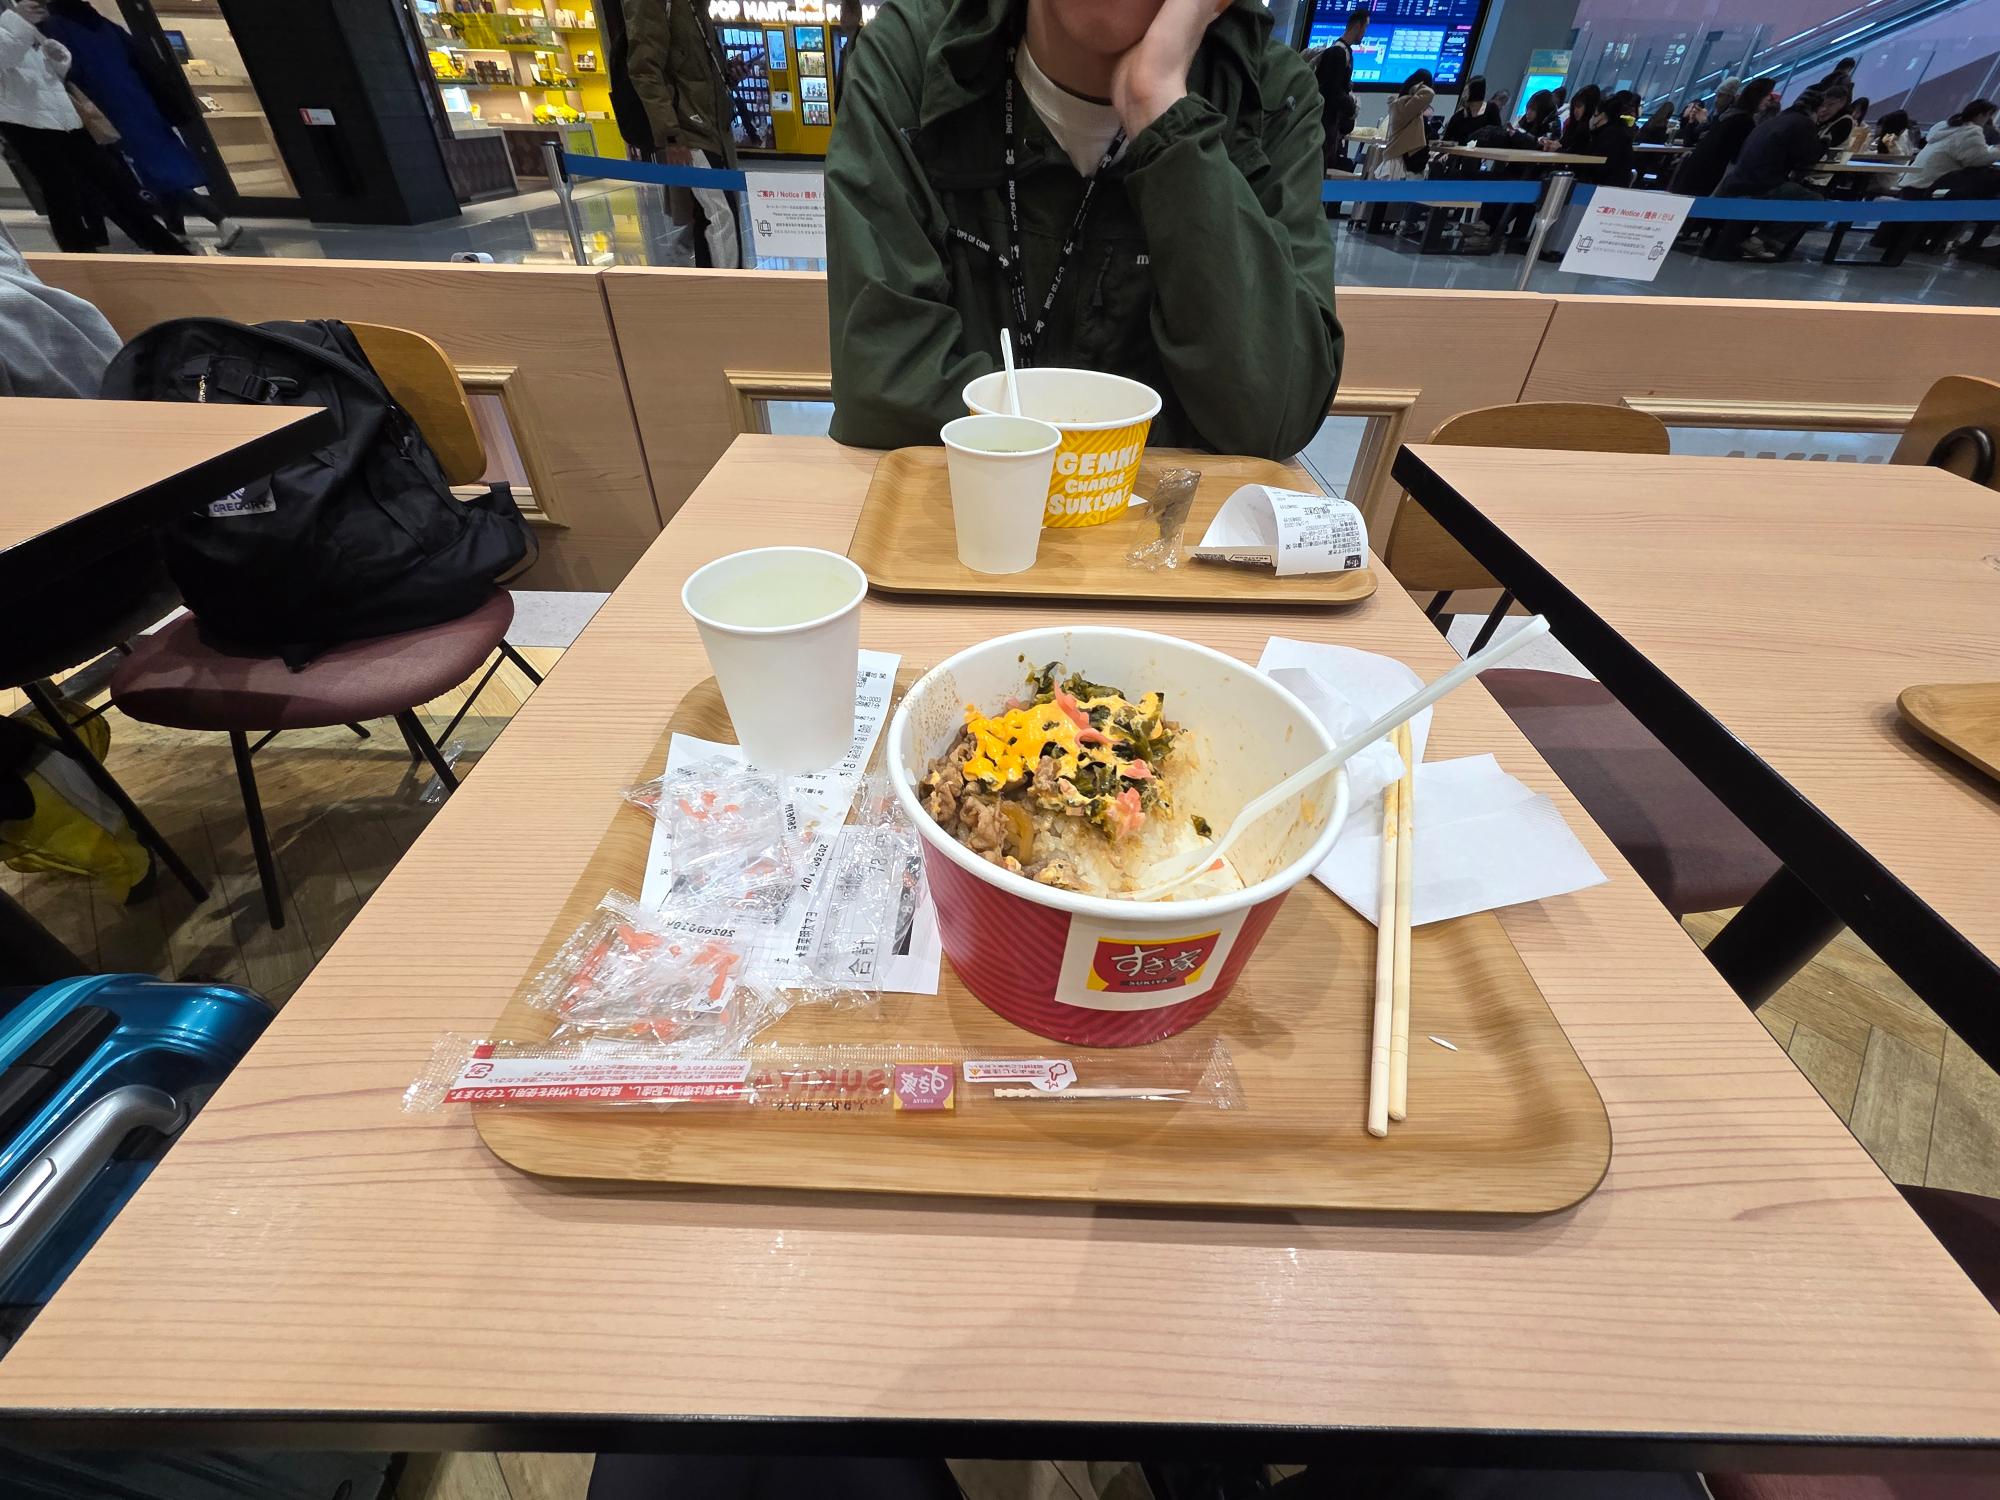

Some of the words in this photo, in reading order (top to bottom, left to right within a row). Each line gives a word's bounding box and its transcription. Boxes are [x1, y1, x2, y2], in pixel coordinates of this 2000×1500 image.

[709, 0, 740, 20] POP
[743, 1, 788, 21] MART
[780, 190, 800, 198] Notice
[1620, 208, 1641, 218] Notice
[1056, 442, 1140, 476] GENKI
[1065, 471, 1126, 494] CHARGE
[1111, 945, 1202, 977] すき家
[1128, 977, 1168, 986] SUKIYA
